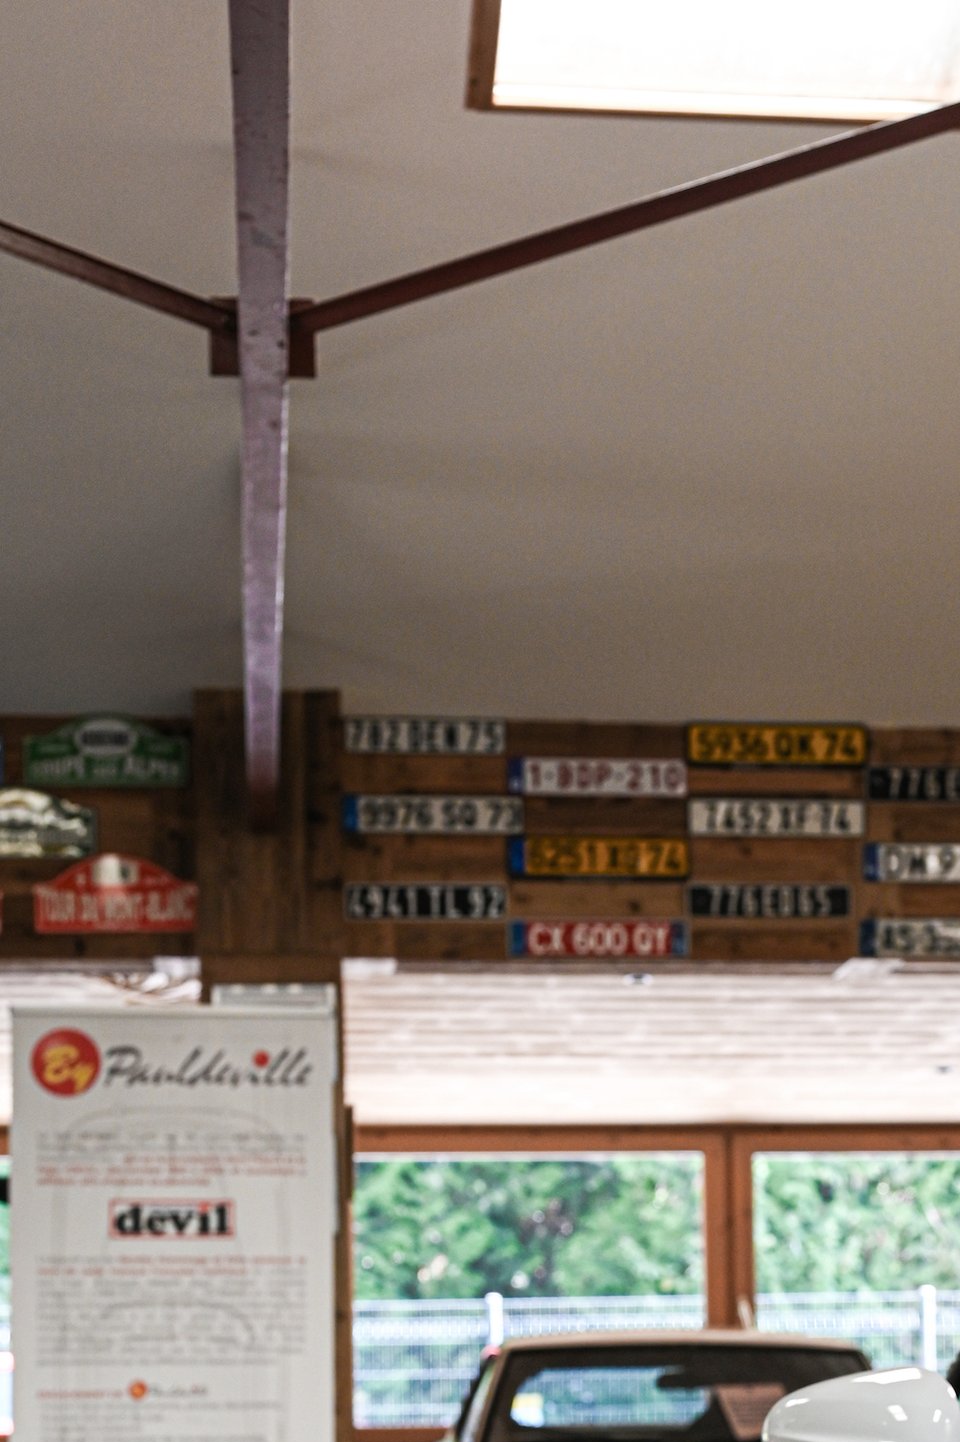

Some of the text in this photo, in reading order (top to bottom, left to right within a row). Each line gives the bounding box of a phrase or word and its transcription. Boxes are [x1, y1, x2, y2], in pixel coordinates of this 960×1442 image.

[823, 729, 858, 759] 74
[527, 922, 567, 956] CX
[572, 922, 628, 956] 600
[114, 1203, 229, 1236] devil
